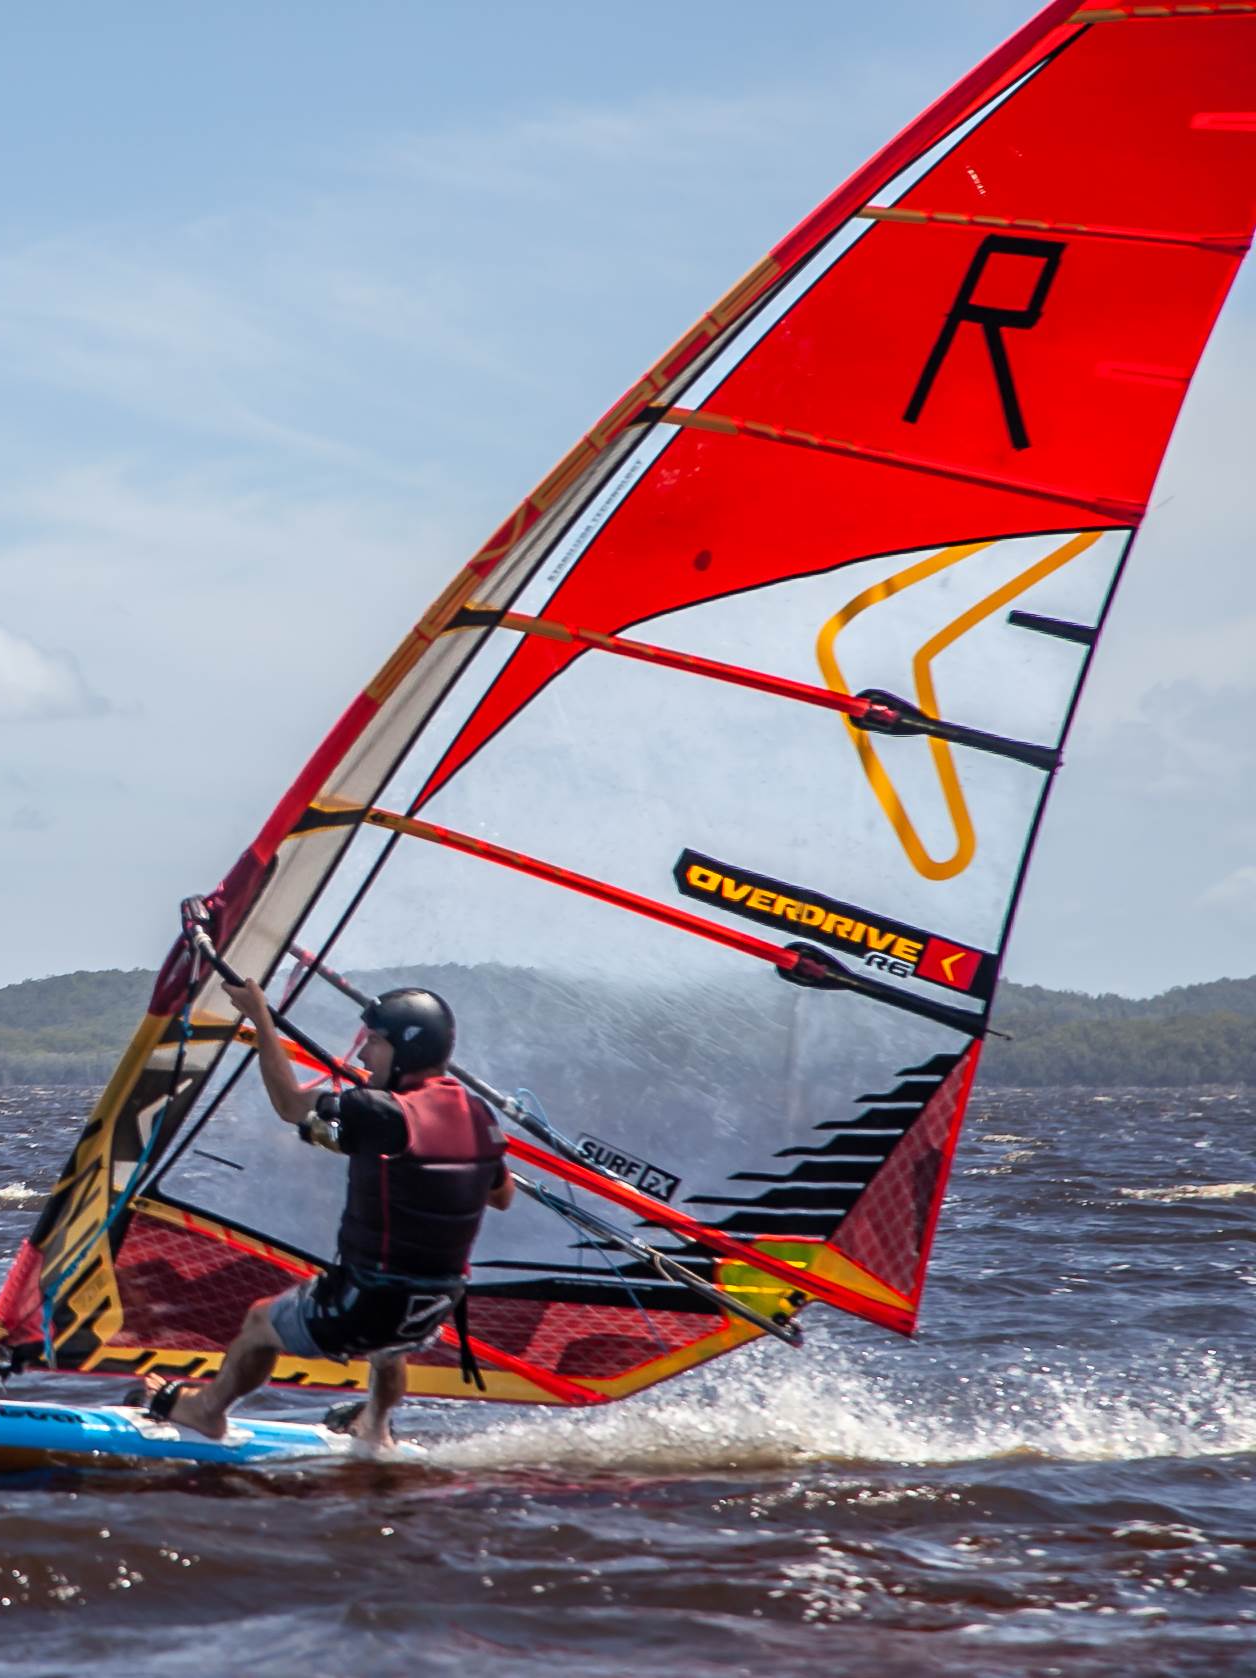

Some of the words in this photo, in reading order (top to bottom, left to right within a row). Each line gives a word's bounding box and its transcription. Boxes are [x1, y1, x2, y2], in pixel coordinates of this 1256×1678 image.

[903, 233, 1069, 451] R
[685, 864, 924, 963] OVERDRIVE
[864, 951, 915, 979] R6
[578, 1140, 642, 1178] SURF
